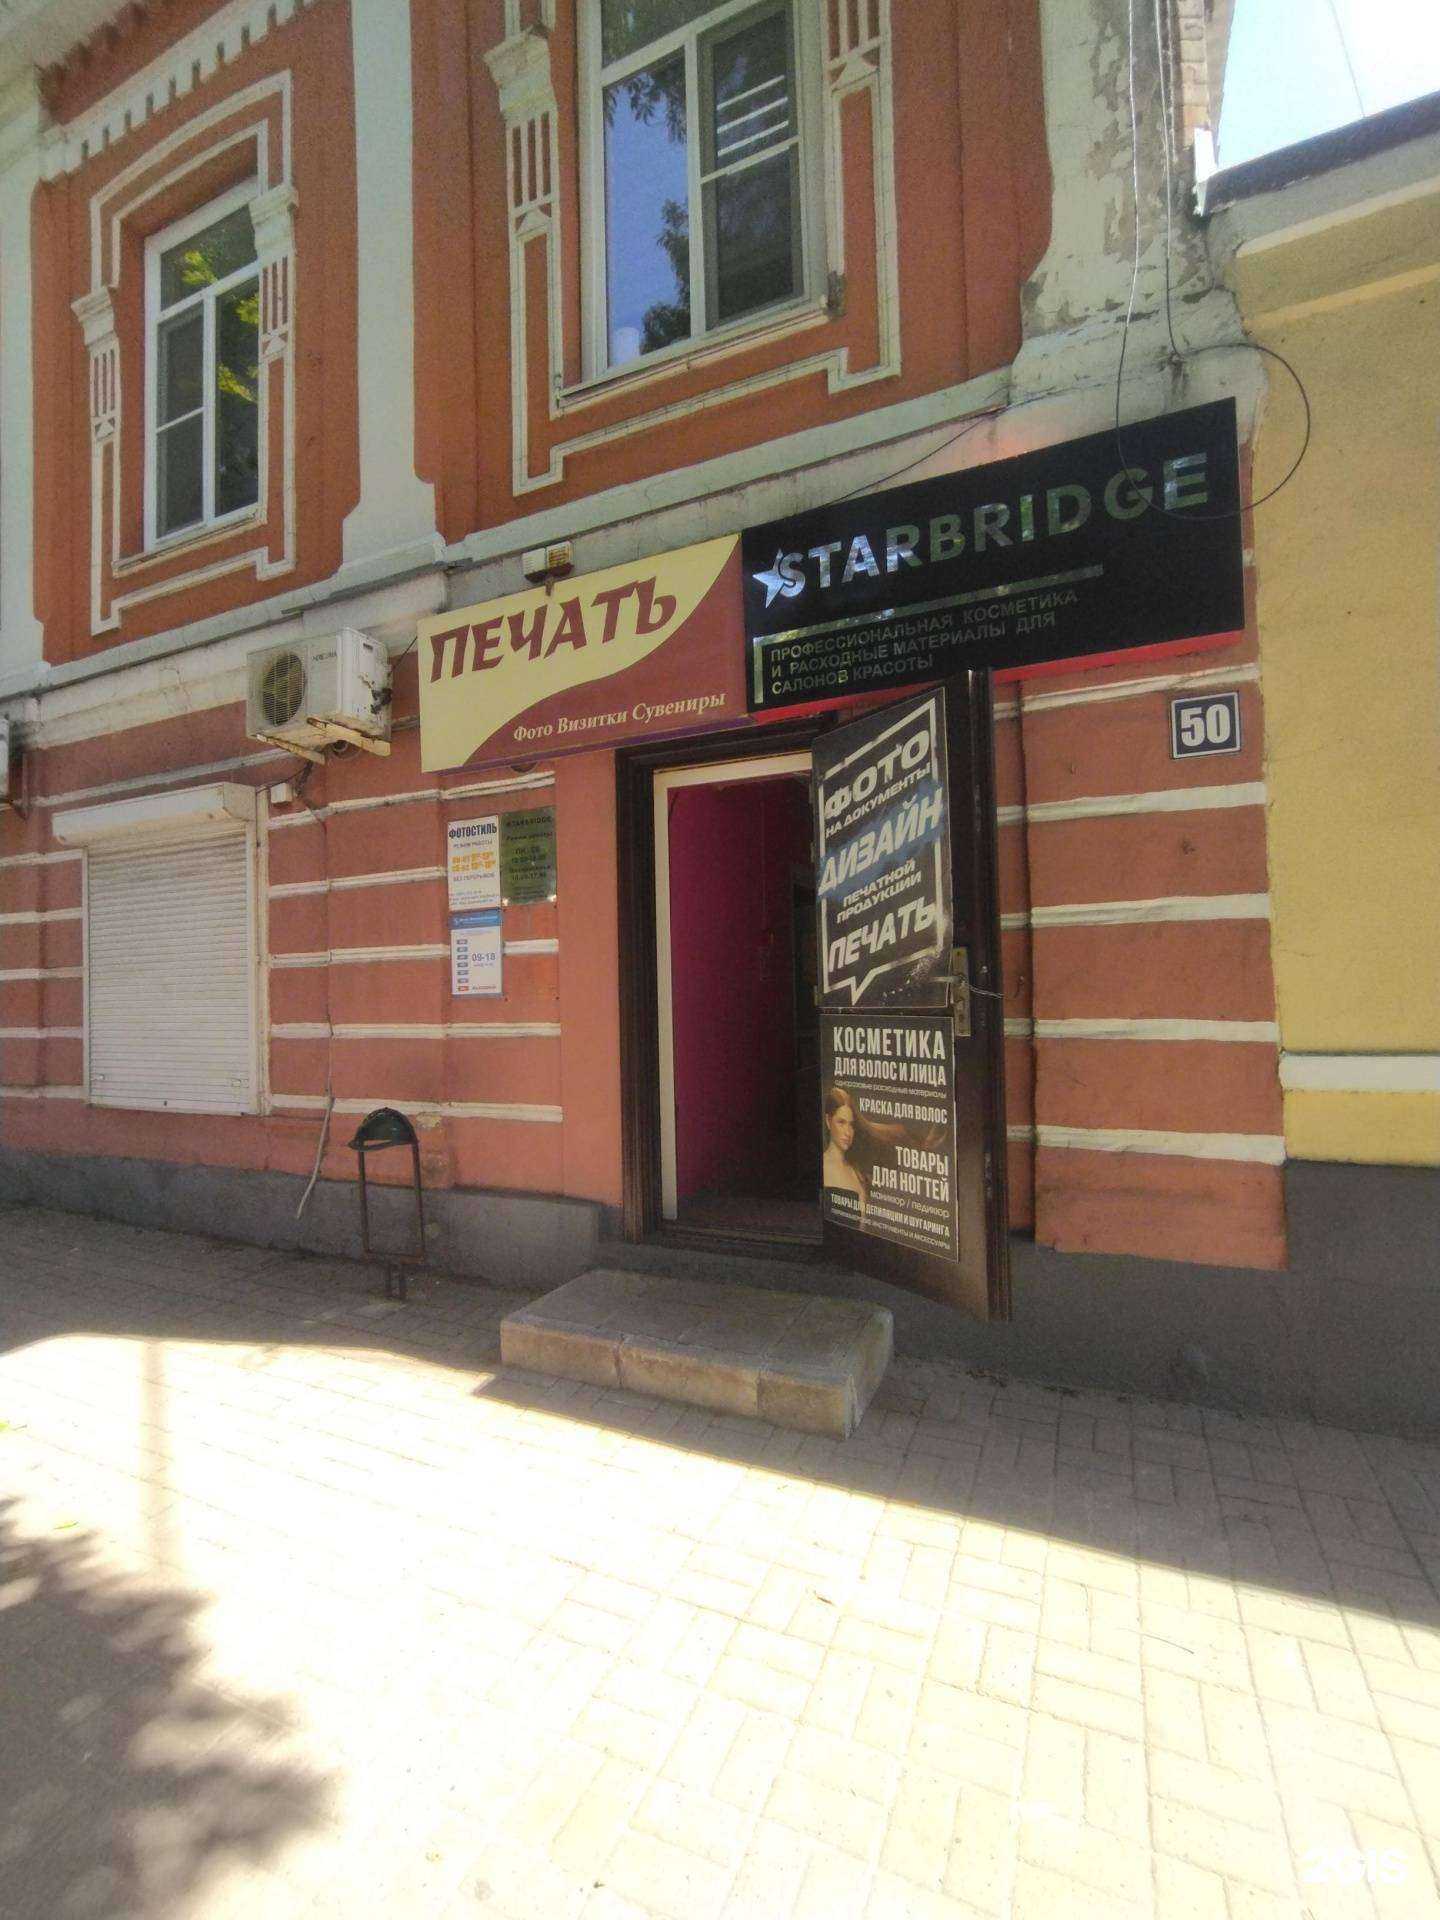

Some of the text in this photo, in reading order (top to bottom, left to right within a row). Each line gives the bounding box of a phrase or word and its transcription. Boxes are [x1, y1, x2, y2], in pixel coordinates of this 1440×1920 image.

[778, 452, 1208, 598] STARBRIDGE
[431, 576, 677, 684] ПЕЧАТЬ
[771, 590, 1078, 662] ПРОФЕССИОНАЛЬНАЯ КОСМЕТИКА
[771, 612, 1056, 678] И РАСХОДНЫЕ МАТЕРИАЛЫ ДЛЯ
[772, 654, 934, 695] САЛОНОВ КРАСОТЫ
[514, 693, 726, 742] Фото Визитки Сувениры
[1181, 704, 1231, 747] 50
[824, 729, 930, 819] ФОТО
[825, 762, 932, 839] НА ДОКУМЕНТЫ
[448, 823, 498, 840] ФОТОСТИЛЬ
[818, 786, 944, 896] ДИЗАЙН
[836, 871, 922, 925] ПРОДУКЦИИ
[843, 857, 916, 907] ПЕЧАТНОЙ
[828, 896, 938, 973] ПЕЧАТЬ
[833, 1026, 946, 1059] КОСМЕТИКА
[834, 1056, 947, 1087] ДЛЯ ВОЛОС И ЛИЦА
[859, 1097, 948, 1125] КРАСКА ДЛЯ ВОЛОС
[871, 1165, 949, 1203] ДЛЯ НОГТЕЙ
[895, 1145, 949, 1176] ТОВАРЫ
[911, 1201, 950, 1219] педикюр
